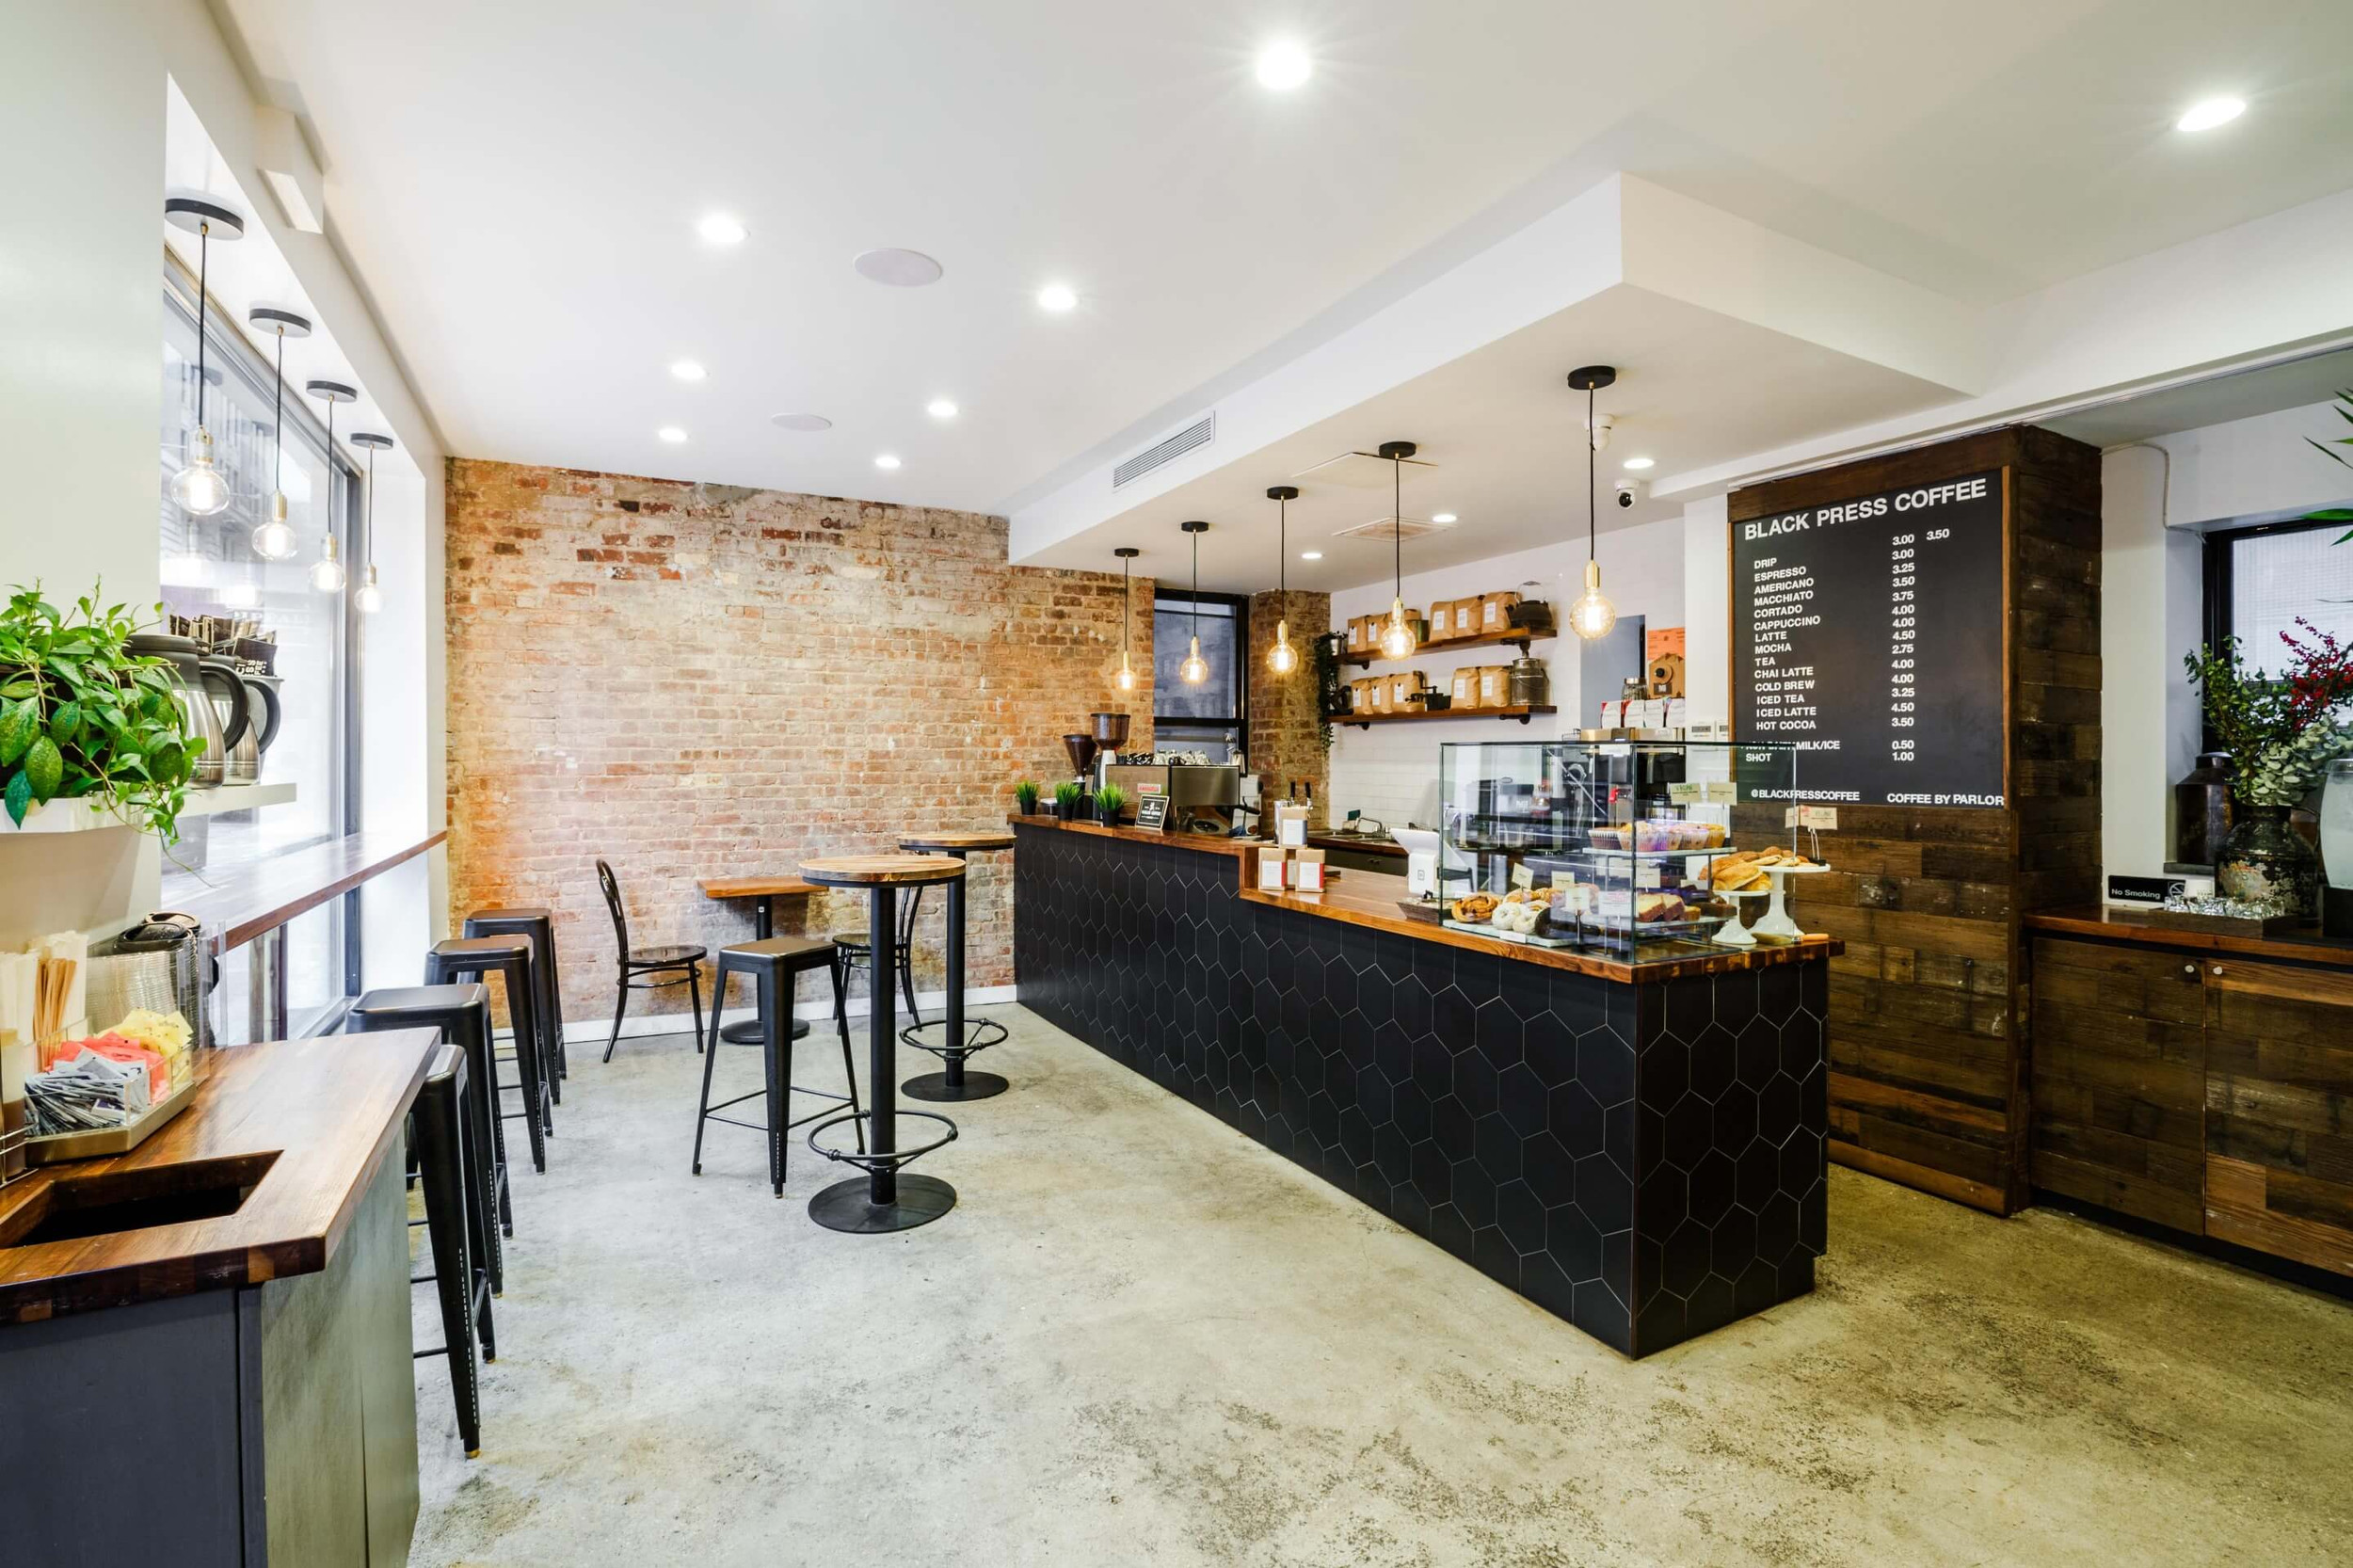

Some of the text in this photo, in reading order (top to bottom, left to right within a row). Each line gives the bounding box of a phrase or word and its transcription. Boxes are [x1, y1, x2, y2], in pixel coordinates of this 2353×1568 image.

[1745, 478, 1987, 540] BLACK PRESS COFFEE
[1754, 529, 1950, 569] DRIP 3.00 3.50
[1754, 549, 1915, 582] ESPRESSO 3.00
[1754, 563, 1915, 595] AMERICANO 3.25
[1754, 576, 1916, 607] MACCHIATO 3.50
[1754, 591, 1914, 618] CORTADO 3.75
[1753, 604, 1915, 632] CAPPUCCINO 4.00
[1755, 617, 1916, 642] LATTE 4.00
[1755, 630, 1916, 654] MOCHA 4.50
[1754, 644, 1914, 666] TEA 2.75
[1754, 659, 1915, 679] CHAI LATTE 4.00
[1755, 673, 1915, 692] COLD BREW 4.00
[1756, 687, 1916, 705] ICED TEA 3.25
[1756, 702, 1915, 717] ICED LATTE 4.50
[1756, 717, 1915, 730] HOT COCOA 3.50
[1796, 741, 1841, 750] MILK/ICE
[1892, 740, 1915, 750] 0.50
[1746, 752, 1915, 761] SHOT 1.00
[1887, 793, 2005, 806] COFFEE BY PARLOR
[2124, 889, 2161, 900] Smoking
